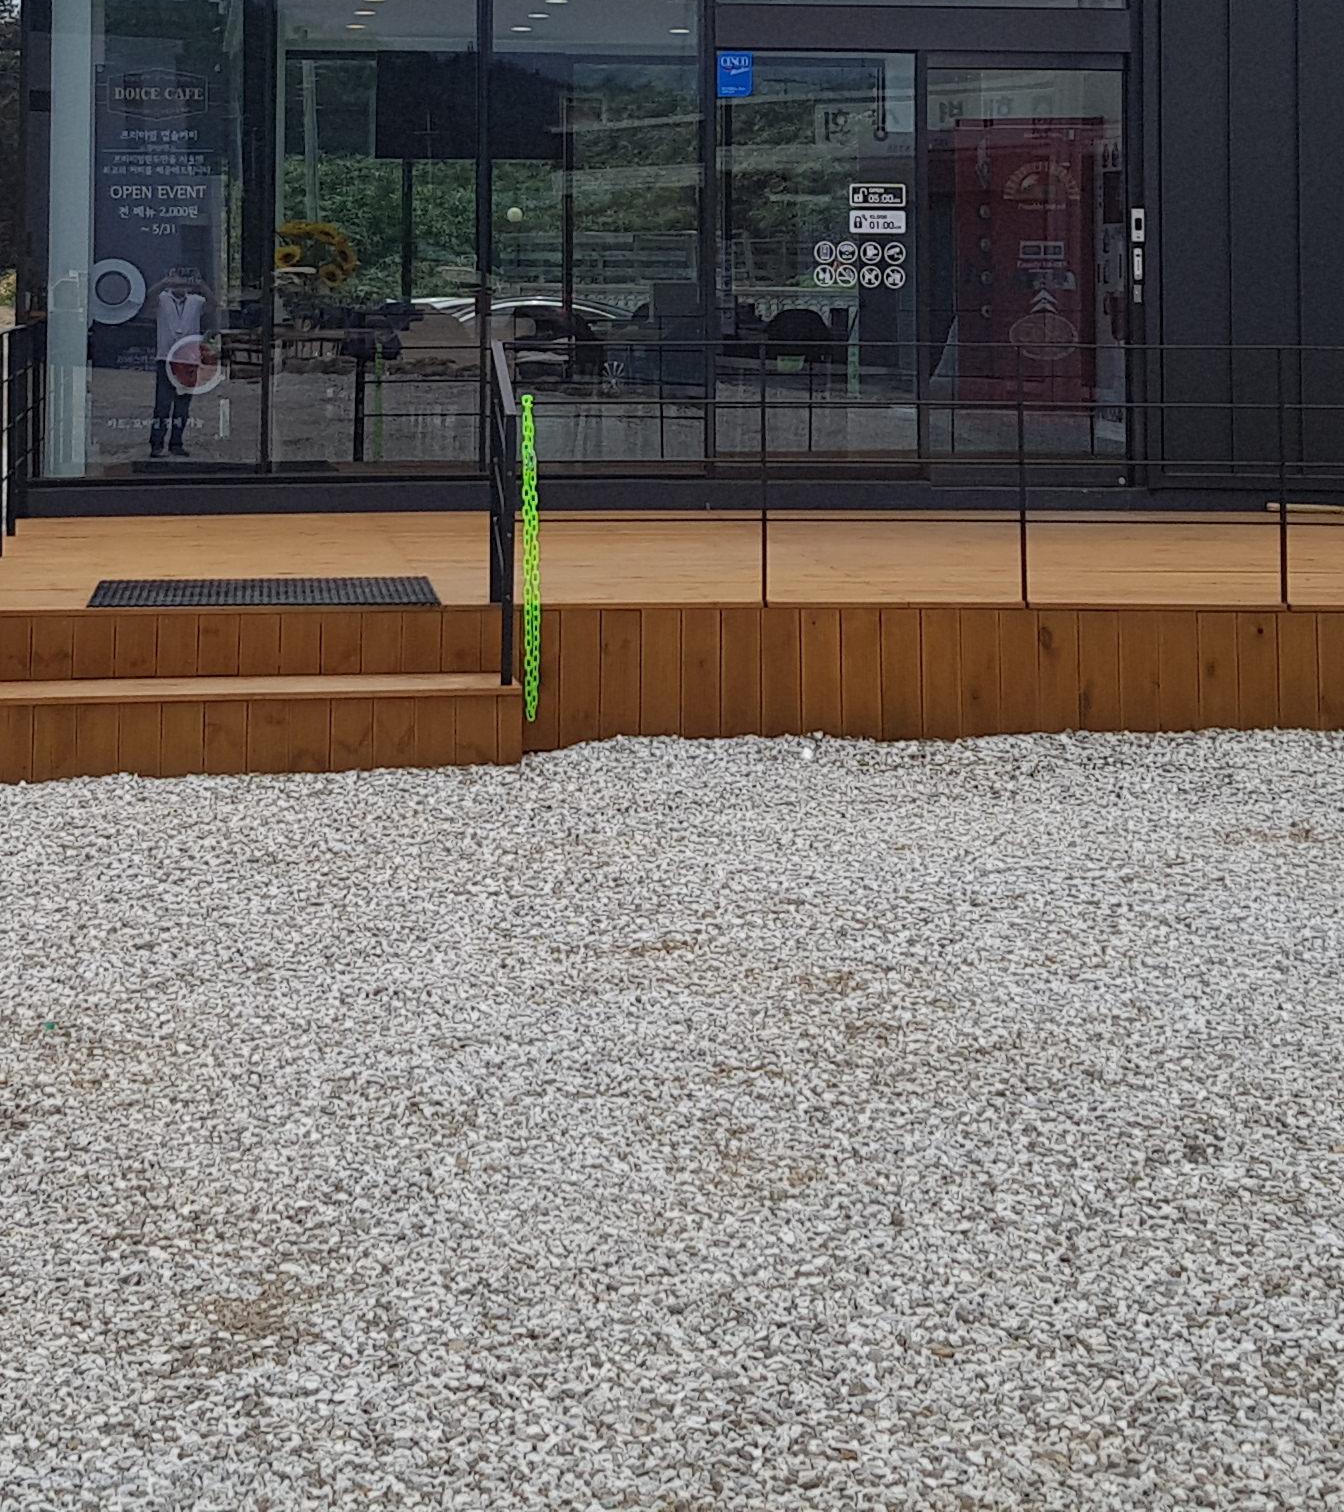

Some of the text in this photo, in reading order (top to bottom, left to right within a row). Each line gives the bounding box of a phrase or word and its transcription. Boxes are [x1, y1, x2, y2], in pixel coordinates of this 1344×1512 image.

[720, 56, 749, 67] CESCO
[164, 87, 204, 100] CAFE
[110, 185, 207, 199] OPEN EVENT
[119, 205, 199, 218] 전 메뉴 2,000원
[152, 223, 176, 236] 5/31
